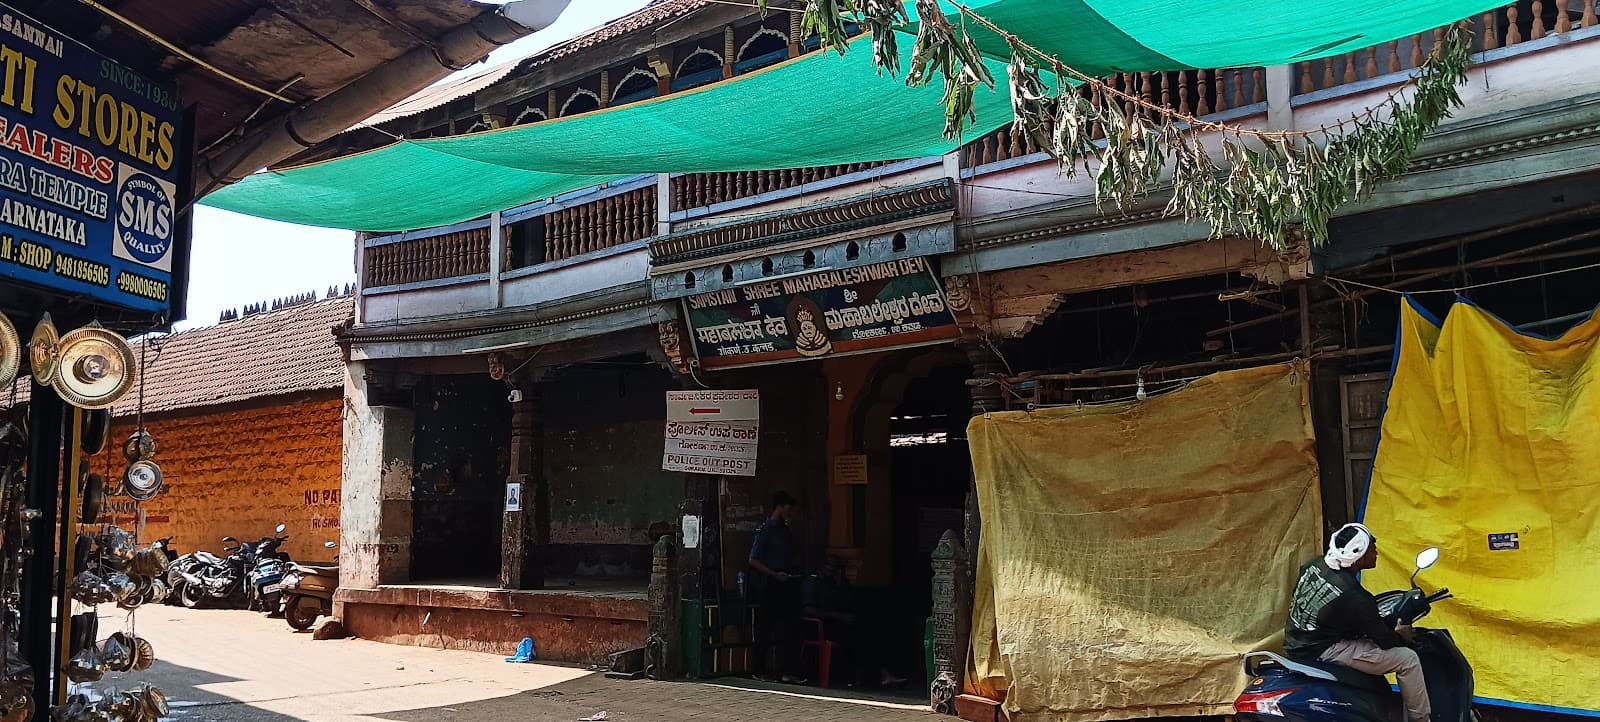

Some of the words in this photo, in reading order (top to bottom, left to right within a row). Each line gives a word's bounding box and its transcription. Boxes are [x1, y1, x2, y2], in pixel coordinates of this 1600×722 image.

[53, 74, 175, 171] STORES
[30, 166, 108, 219] TEMPLE
[128, 180, 156, 194] SYMBOL
[157, 191, 166, 202] OF
[0, 198, 86, 247] ARNATAKA
[119, 190, 171, 240] SMS
[124, 231, 165, 254] QUALITY
[19, 241, 52, 270] SHOP
[56, 254, 110, 286] 9481856505
[688, 289, 738, 310] SAMSTAN
[743, 281, 781, 299] SHREE
[783, 264, 899, 295] MAHABALESHWAR
[900, 257, 925, 276] DEV
[843, 288, 858, 303] ಶ್ರೀ
[667, 454, 700, 466] POLICE
[702, 457, 720, 467] OUT
[722, 459, 751, 470] POST
[304, 488, 319, 505] NO
[322, 517, 341, 528] SMO
